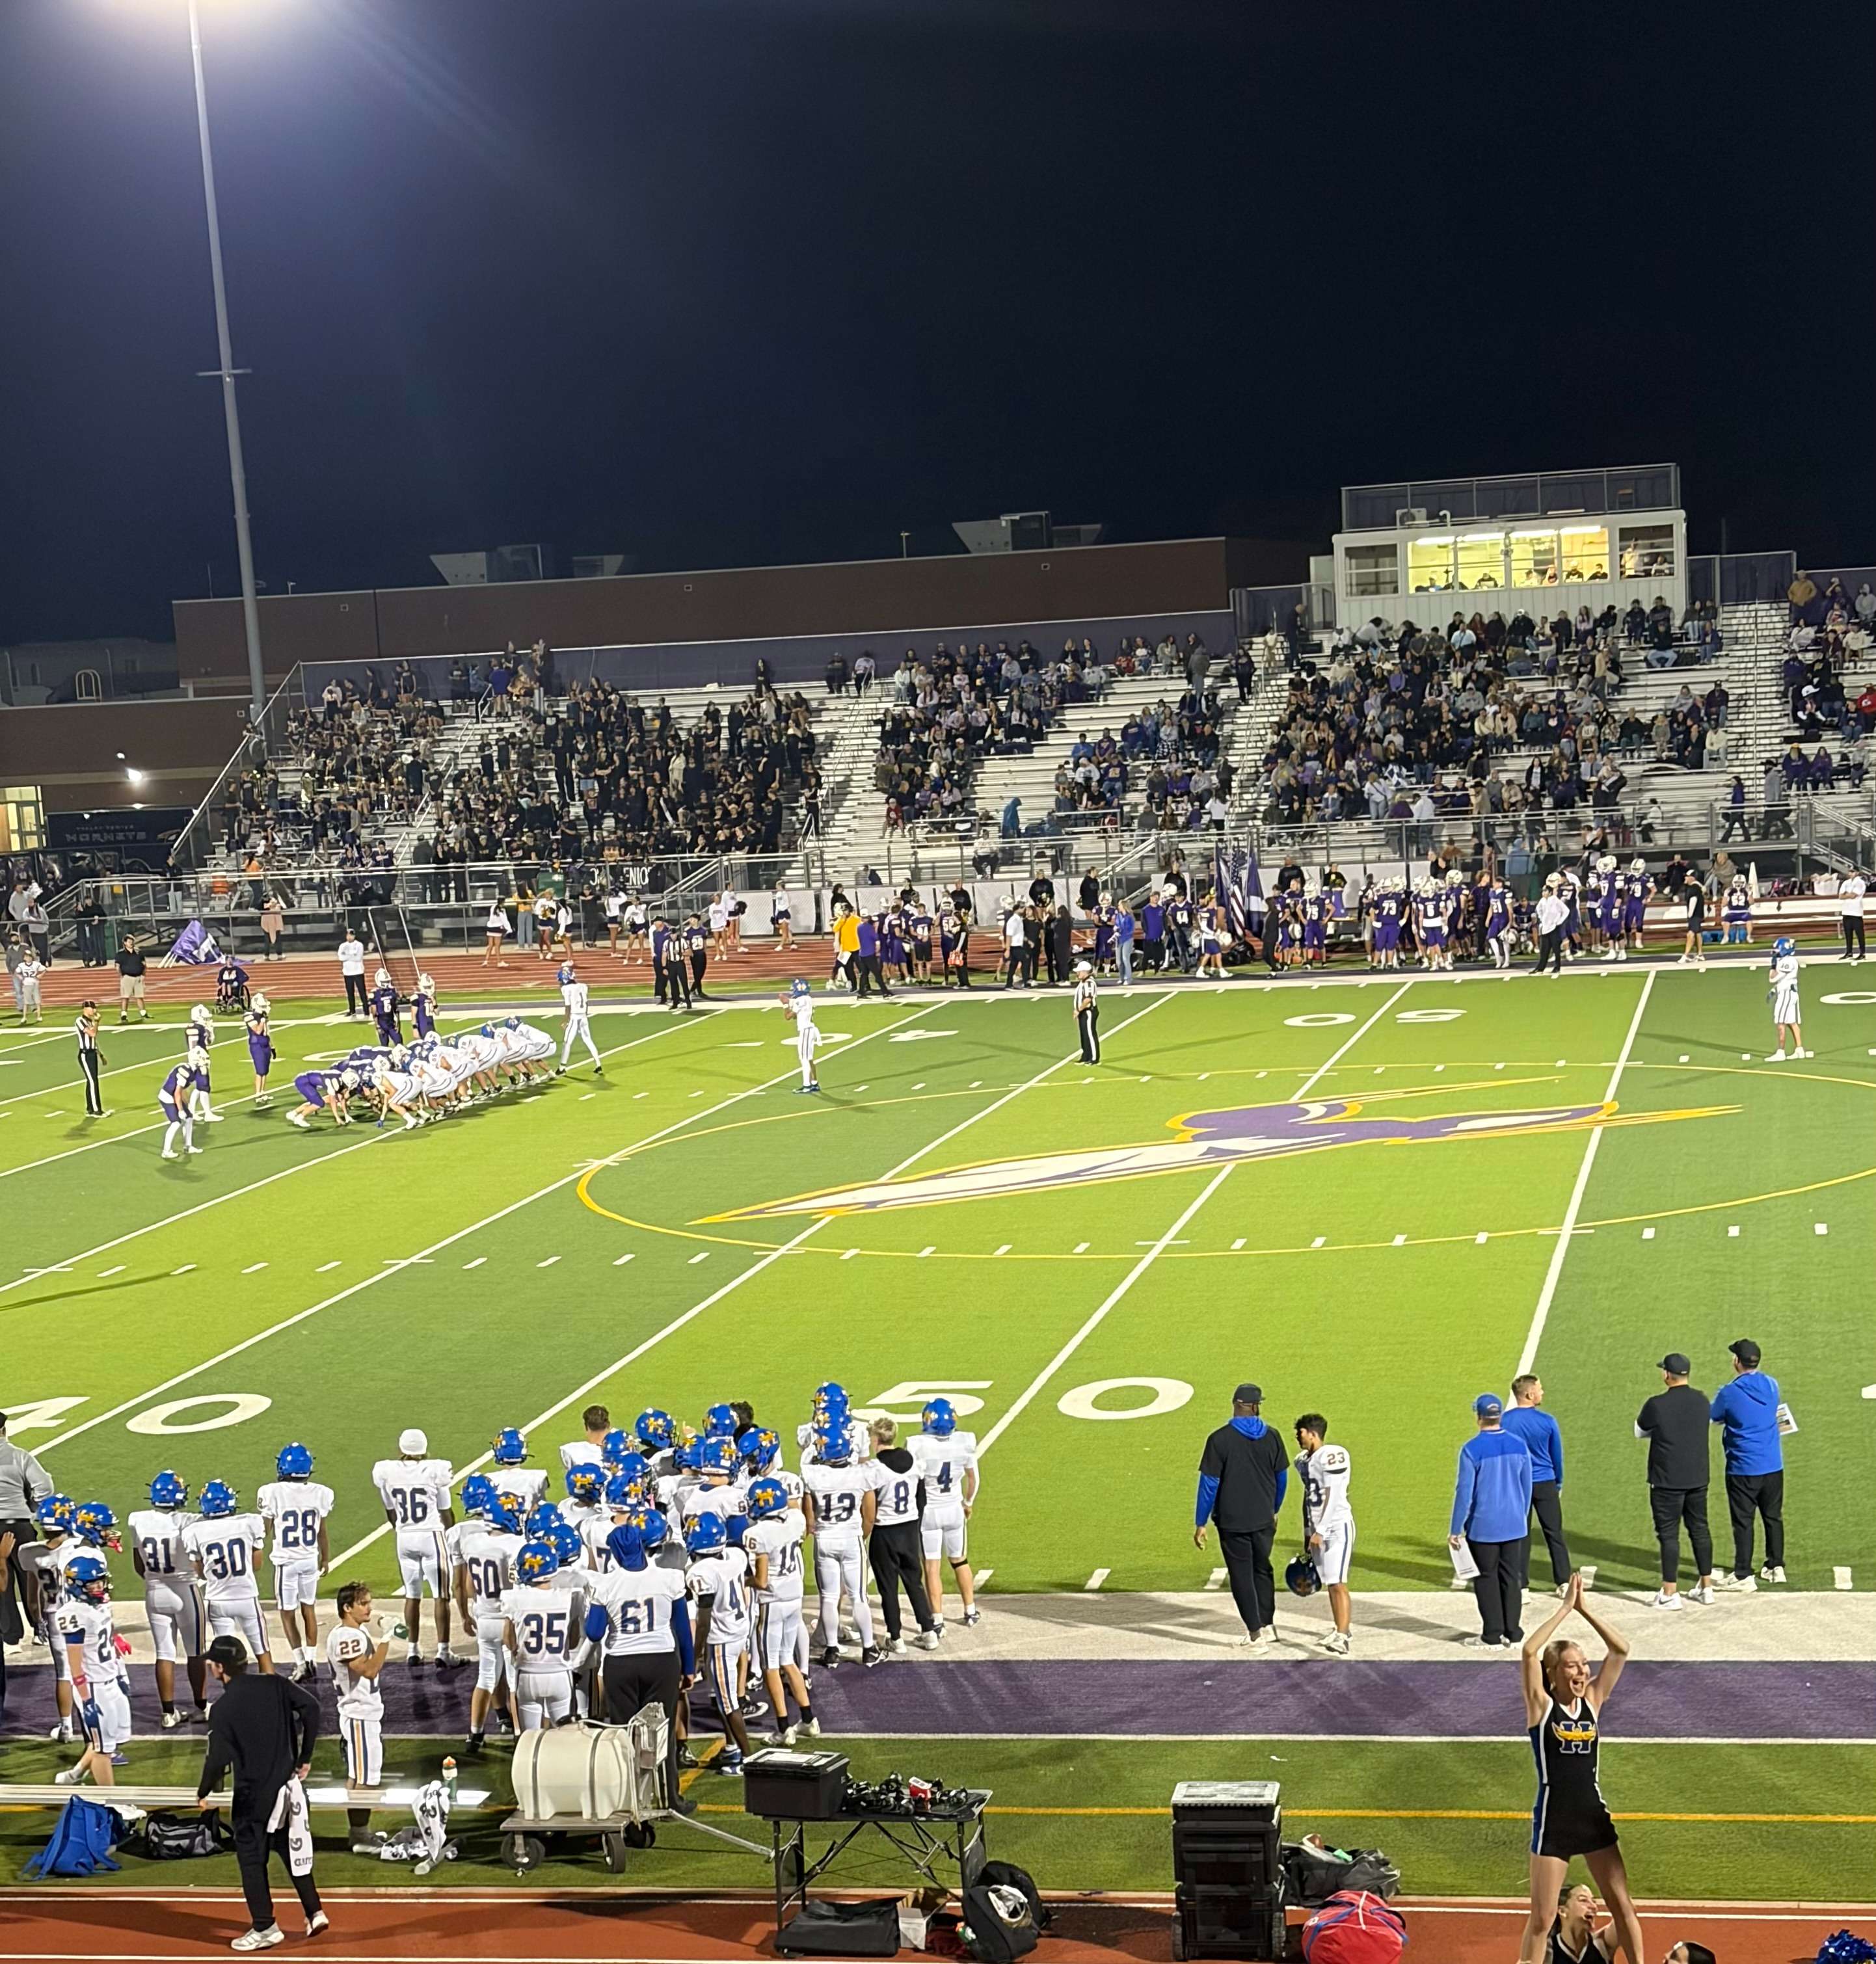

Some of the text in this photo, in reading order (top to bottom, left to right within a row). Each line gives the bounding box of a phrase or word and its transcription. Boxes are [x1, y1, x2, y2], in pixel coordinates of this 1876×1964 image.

[1382, 902, 1397, 916] 73
[691, 937, 704, 950] 29
[1326, 1452, 1345, 1466] 23
[786, 1481, 801, 1495] 14
[937, 1461, 954, 1494] 4
[391, 1487, 428, 1524] 36
[894, 1480, 910, 1515] 8
[282, 1509, 317, 1548] 28
[142, 1536, 176, 1574] 31
[206, 1537, 247, 1580] 30
[468, 1556, 502, 1600] 60
[57, 1614, 79, 1630] 24
[523, 1612, 567, 1654] 35
[619, 1597, 657, 1635] 61
[339, 1638, 362, 1656] 22
